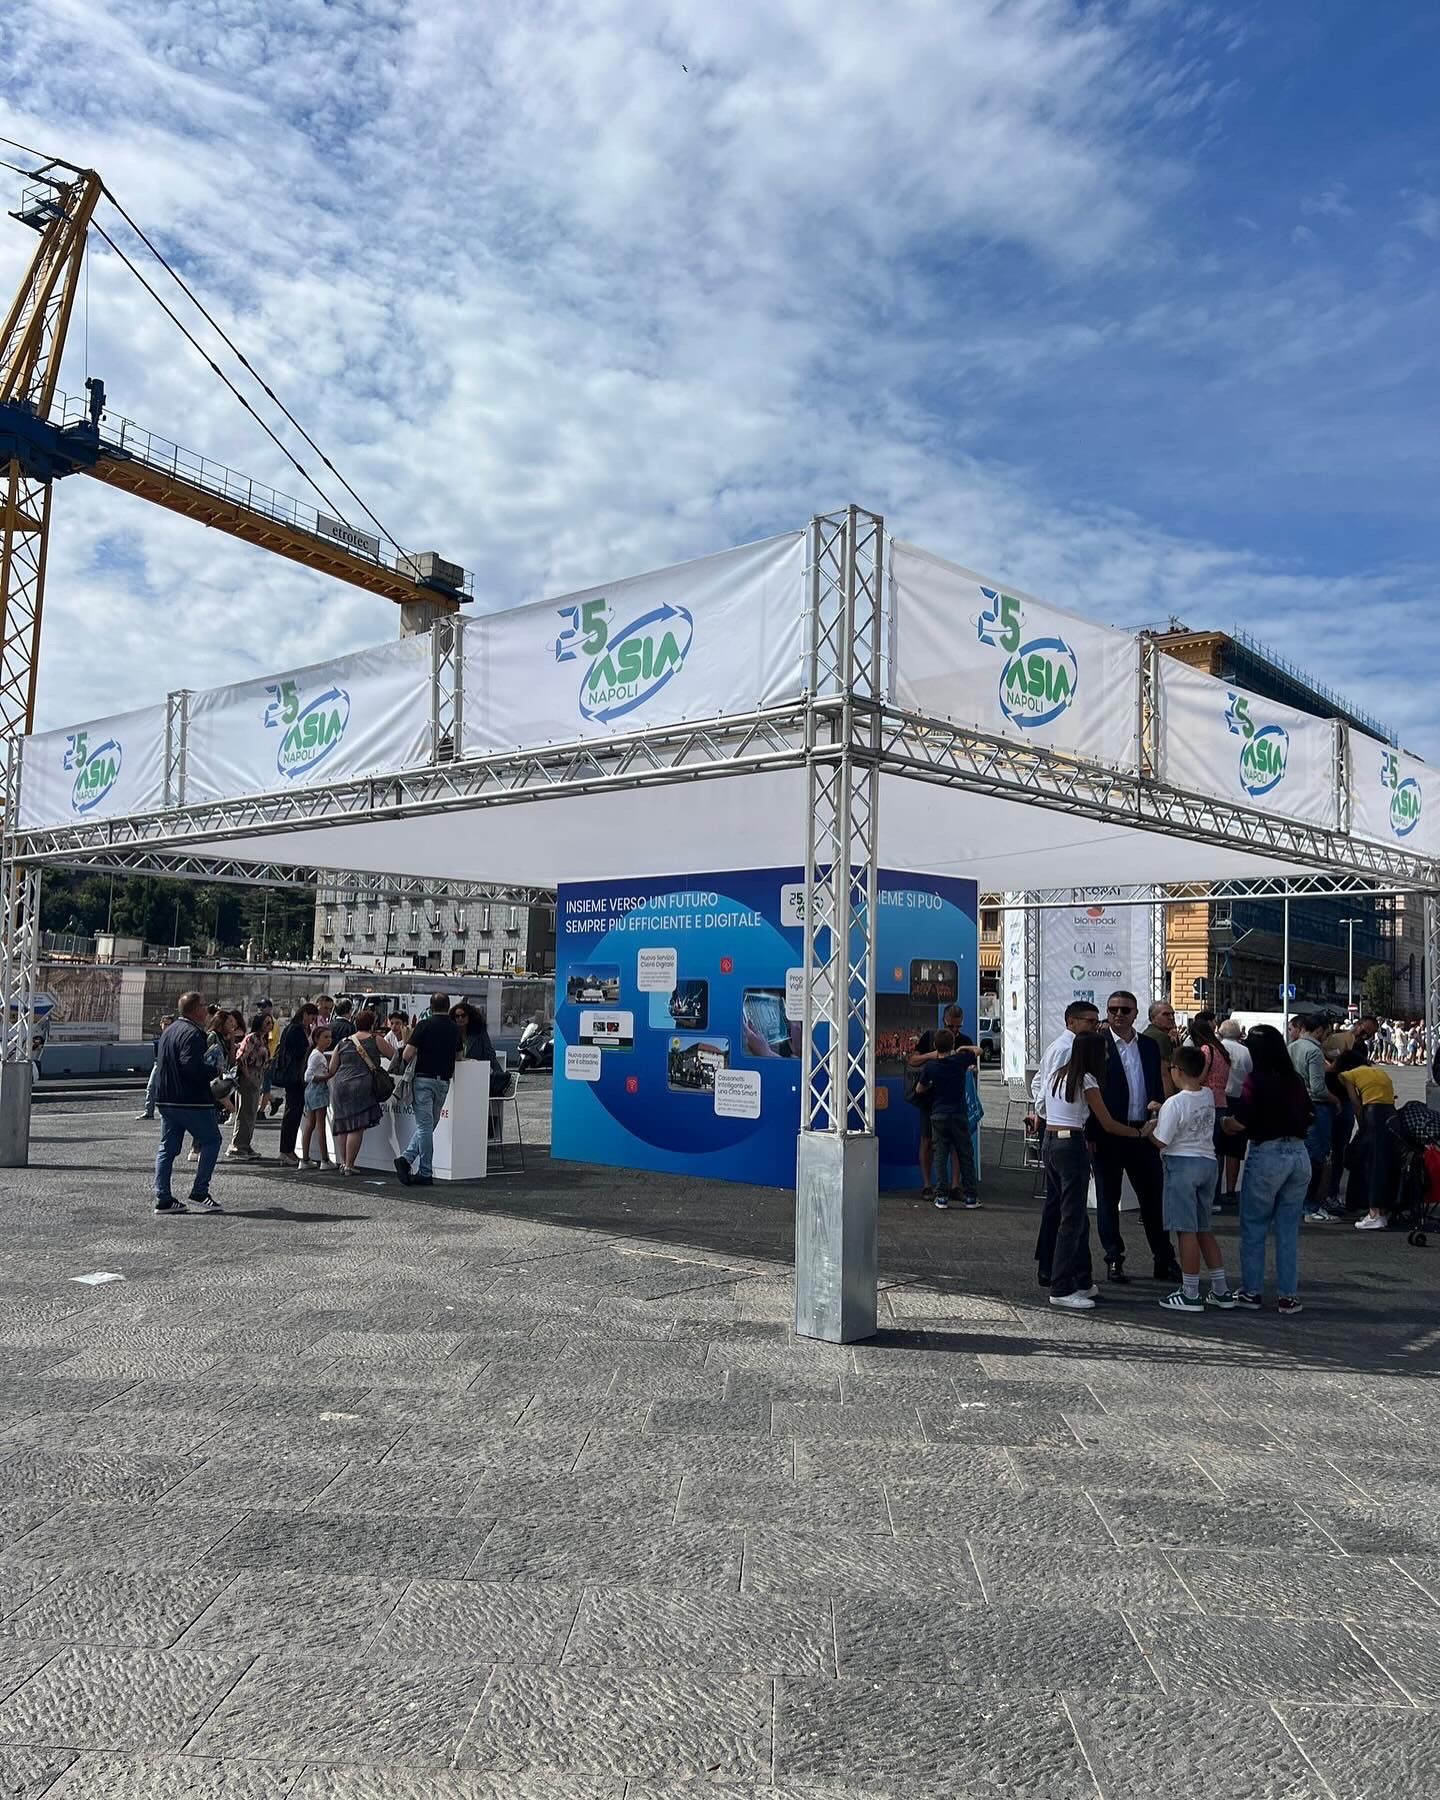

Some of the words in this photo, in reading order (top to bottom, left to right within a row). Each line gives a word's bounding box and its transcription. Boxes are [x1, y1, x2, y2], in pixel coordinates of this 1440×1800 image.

[588, 632, 682, 690] ASIA
[1006, 654, 1072, 707] ASIA
[588, 684, 638, 705] NAPOLI
[1007, 691, 1043, 713] NAPOLI
[284, 709, 343, 752] ASIA
[283, 750, 315, 763] NAPOLI
[1243, 738, 1284, 778] ASIA
[77, 757, 117, 791] ASIA
[566, 898, 607, 914] INSIEME
[609, 896, 646, 912] VERSO
[650, 895, 666, 910] UN
[669, 892, 718, 909] FUTURO
[858, 889, 904, 906] INIEME
[906, 893, 916, 908] SI
[918, 891, 943, 910] PUÒ
[565, 918, 607, 934] SEMPRE
[609, 914, 626, 932] PIÙ
[629, 914, 691, 931] EFFICIENTE
[695, 914, 702, 929] E
[705, 912, 761, 928] DIGITALE
[1087, 968, 1122, 977] comieco
